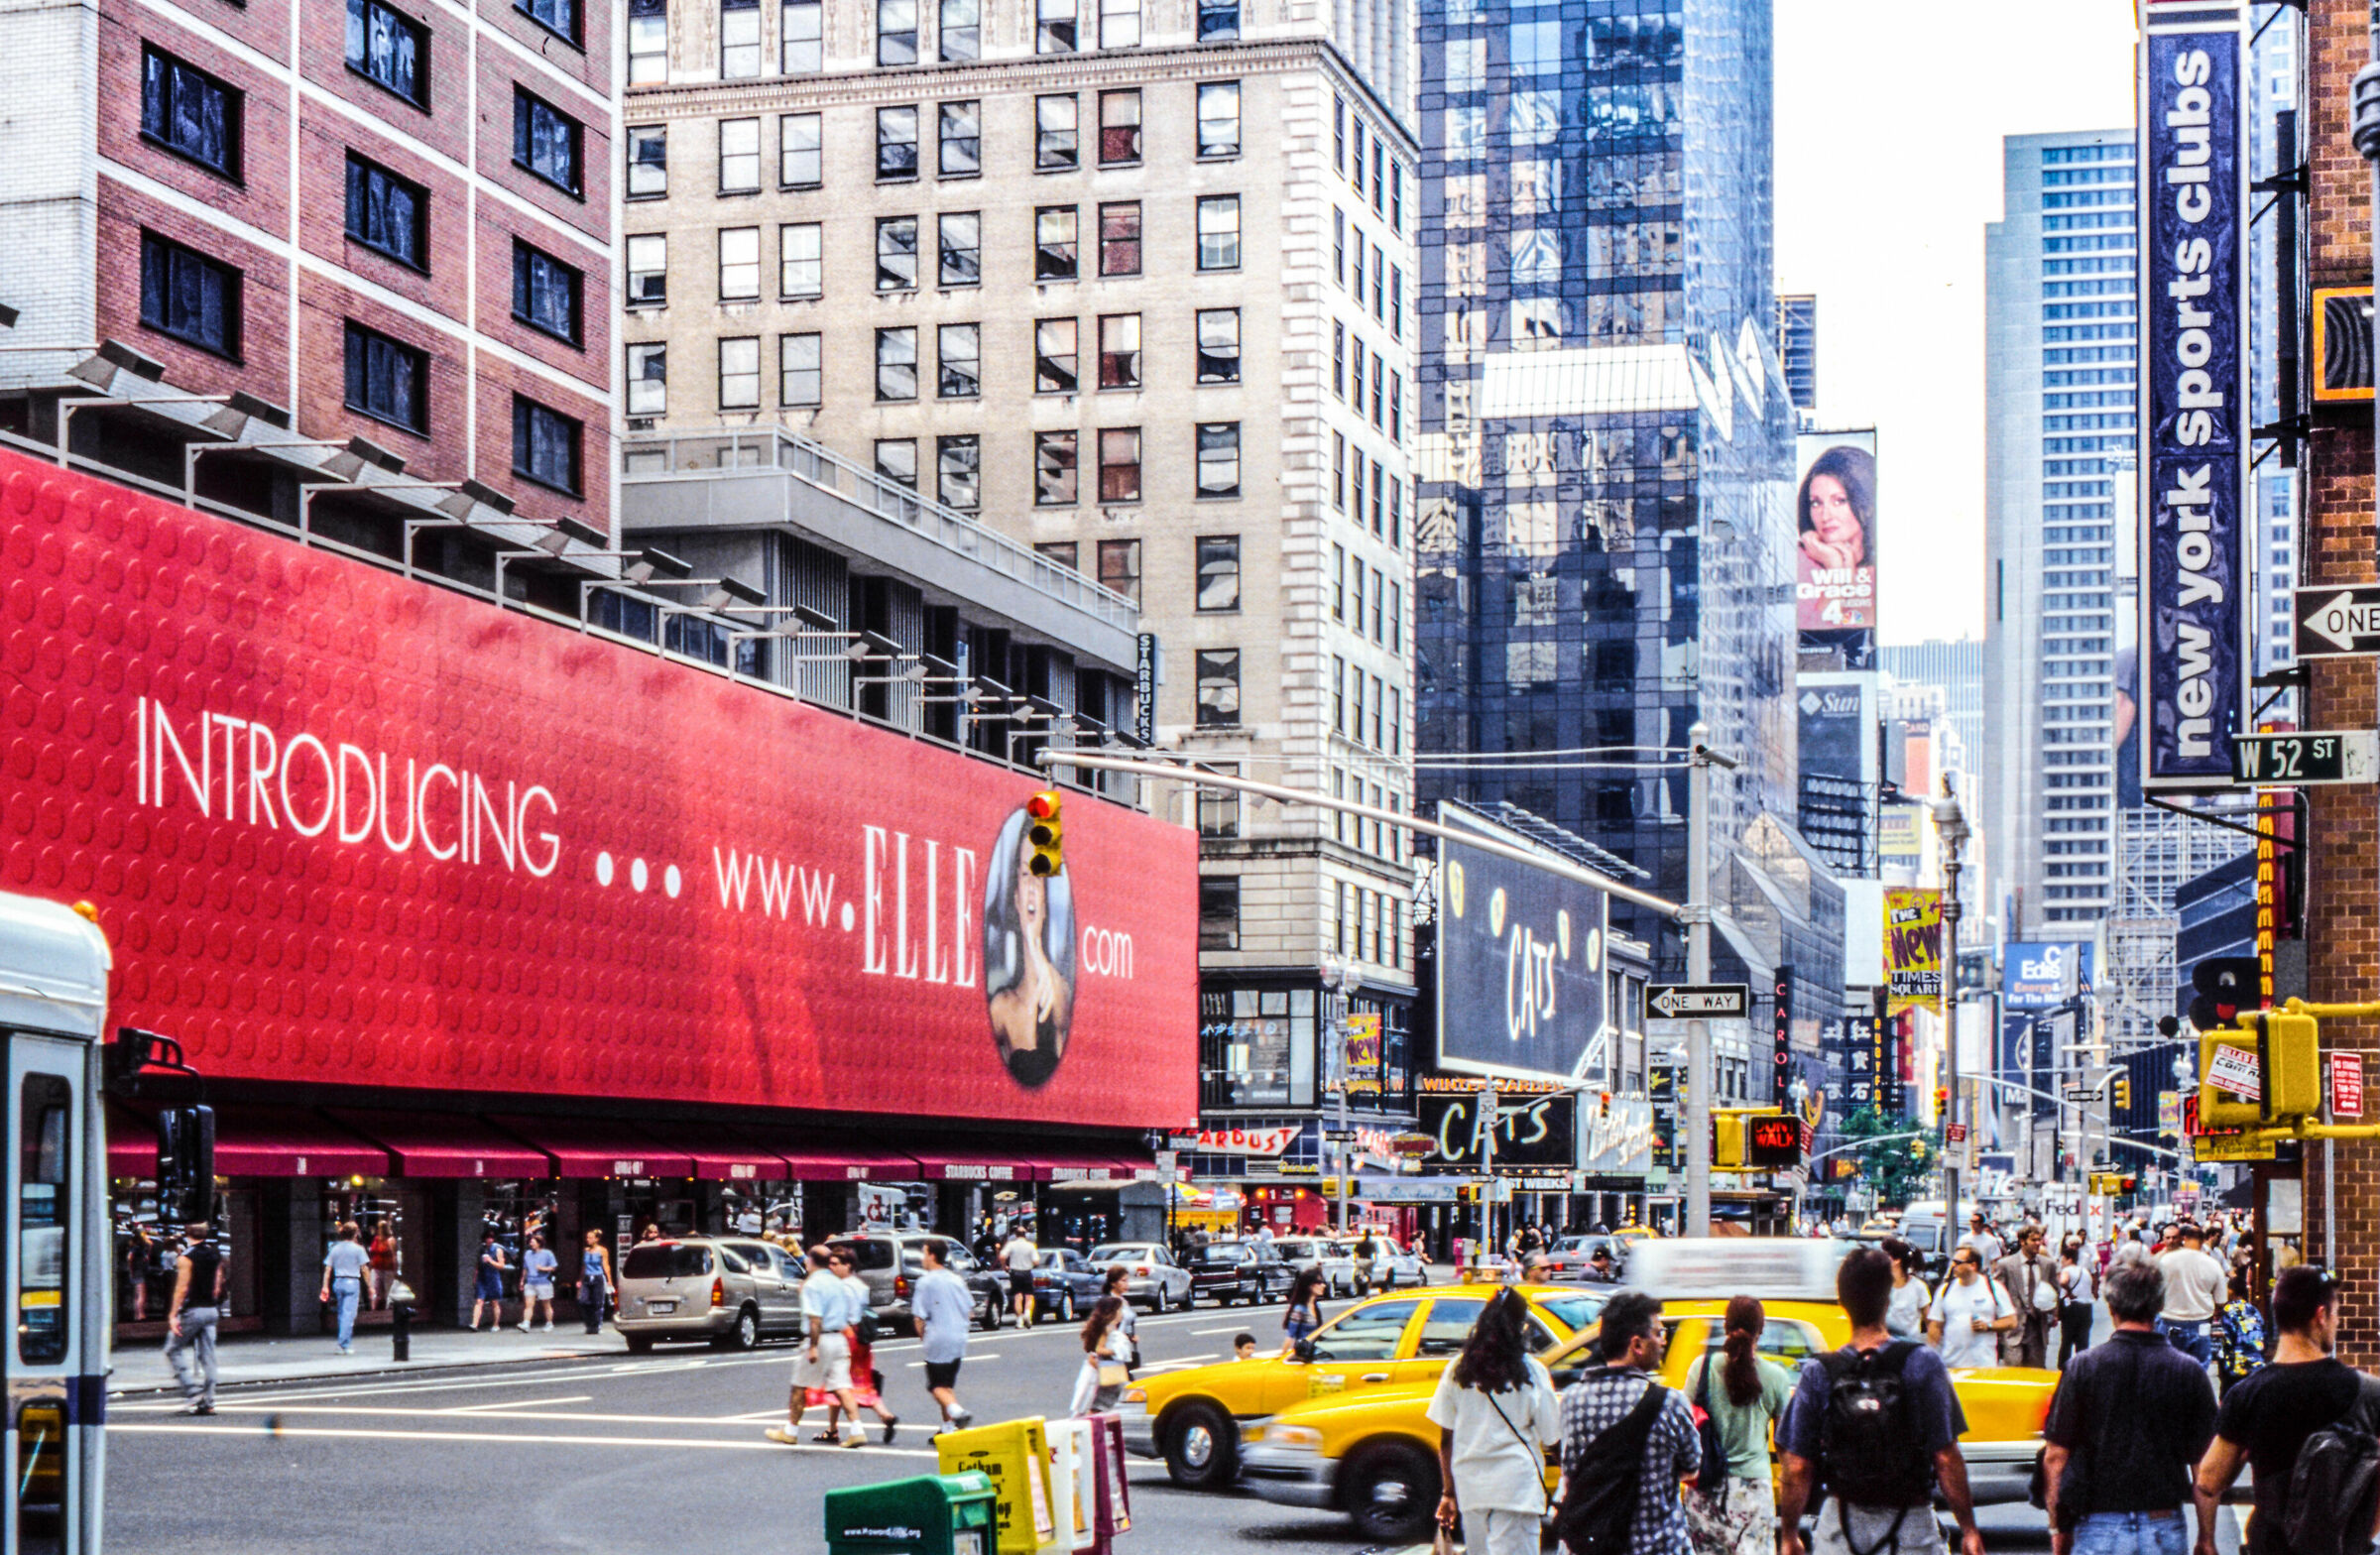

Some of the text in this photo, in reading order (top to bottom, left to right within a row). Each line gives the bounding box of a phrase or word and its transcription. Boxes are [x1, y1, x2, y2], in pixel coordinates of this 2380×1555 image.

[2167, 49, 2223, 758] new york sports clubs
[1811, 568, 1872, 585] Will &
[1797, 583, 1871, 599] Grace
[1822, 599, 1843, 625] 4
[1138, 635, 1150, 739] STARBUCKS
[1823, 692, 1859, 713] Sun
[2239, 738, 2335, 778] W 52 ST
[138, 696, 560, 878] INTRODUCING
[862, 824, 976, 988] ELLE
[1083, 925, 1133, 980] com
[1506, 923, 1557, 1040] CATS
[1892, 971, 1941, 984] TIMES
[1661, 996, 1733, 1010] ONE WAY
[1481, 1104, 1494, 1114] 30
[1440, 1101, 1552, 1161] CATS
[1757, 1134, 1795, 1148] WALK
[945, 1164, 987, 1179] STARBUCKS
[2044, 1199, 2103, 1217] Fedx
